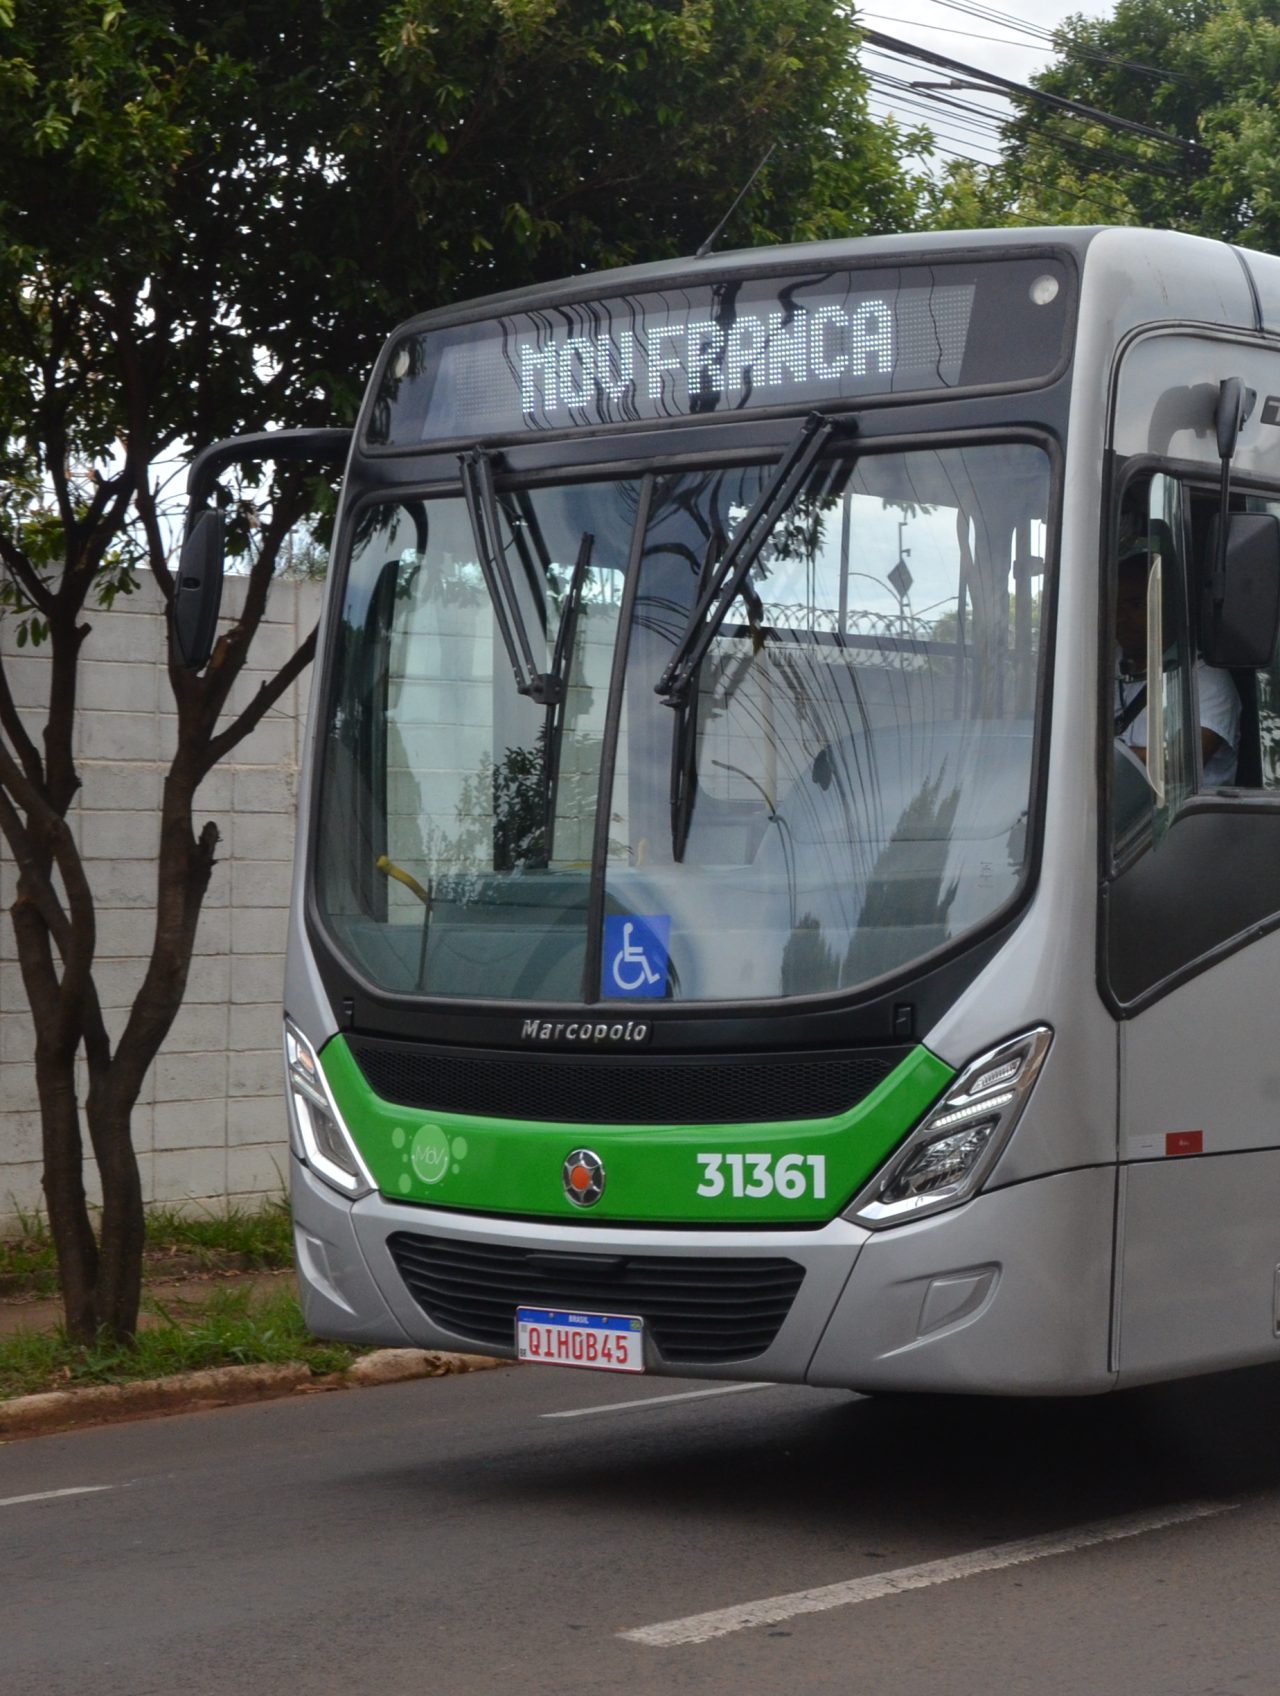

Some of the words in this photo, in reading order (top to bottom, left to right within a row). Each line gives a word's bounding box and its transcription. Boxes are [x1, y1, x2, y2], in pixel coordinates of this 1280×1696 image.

[521, 331, 634, 413] MOV
[648, 300, 892, 399] FRANCA
[521, 1019, 647, 1043] Marcopolo
[696, 1153, 825, 1198] 31361
